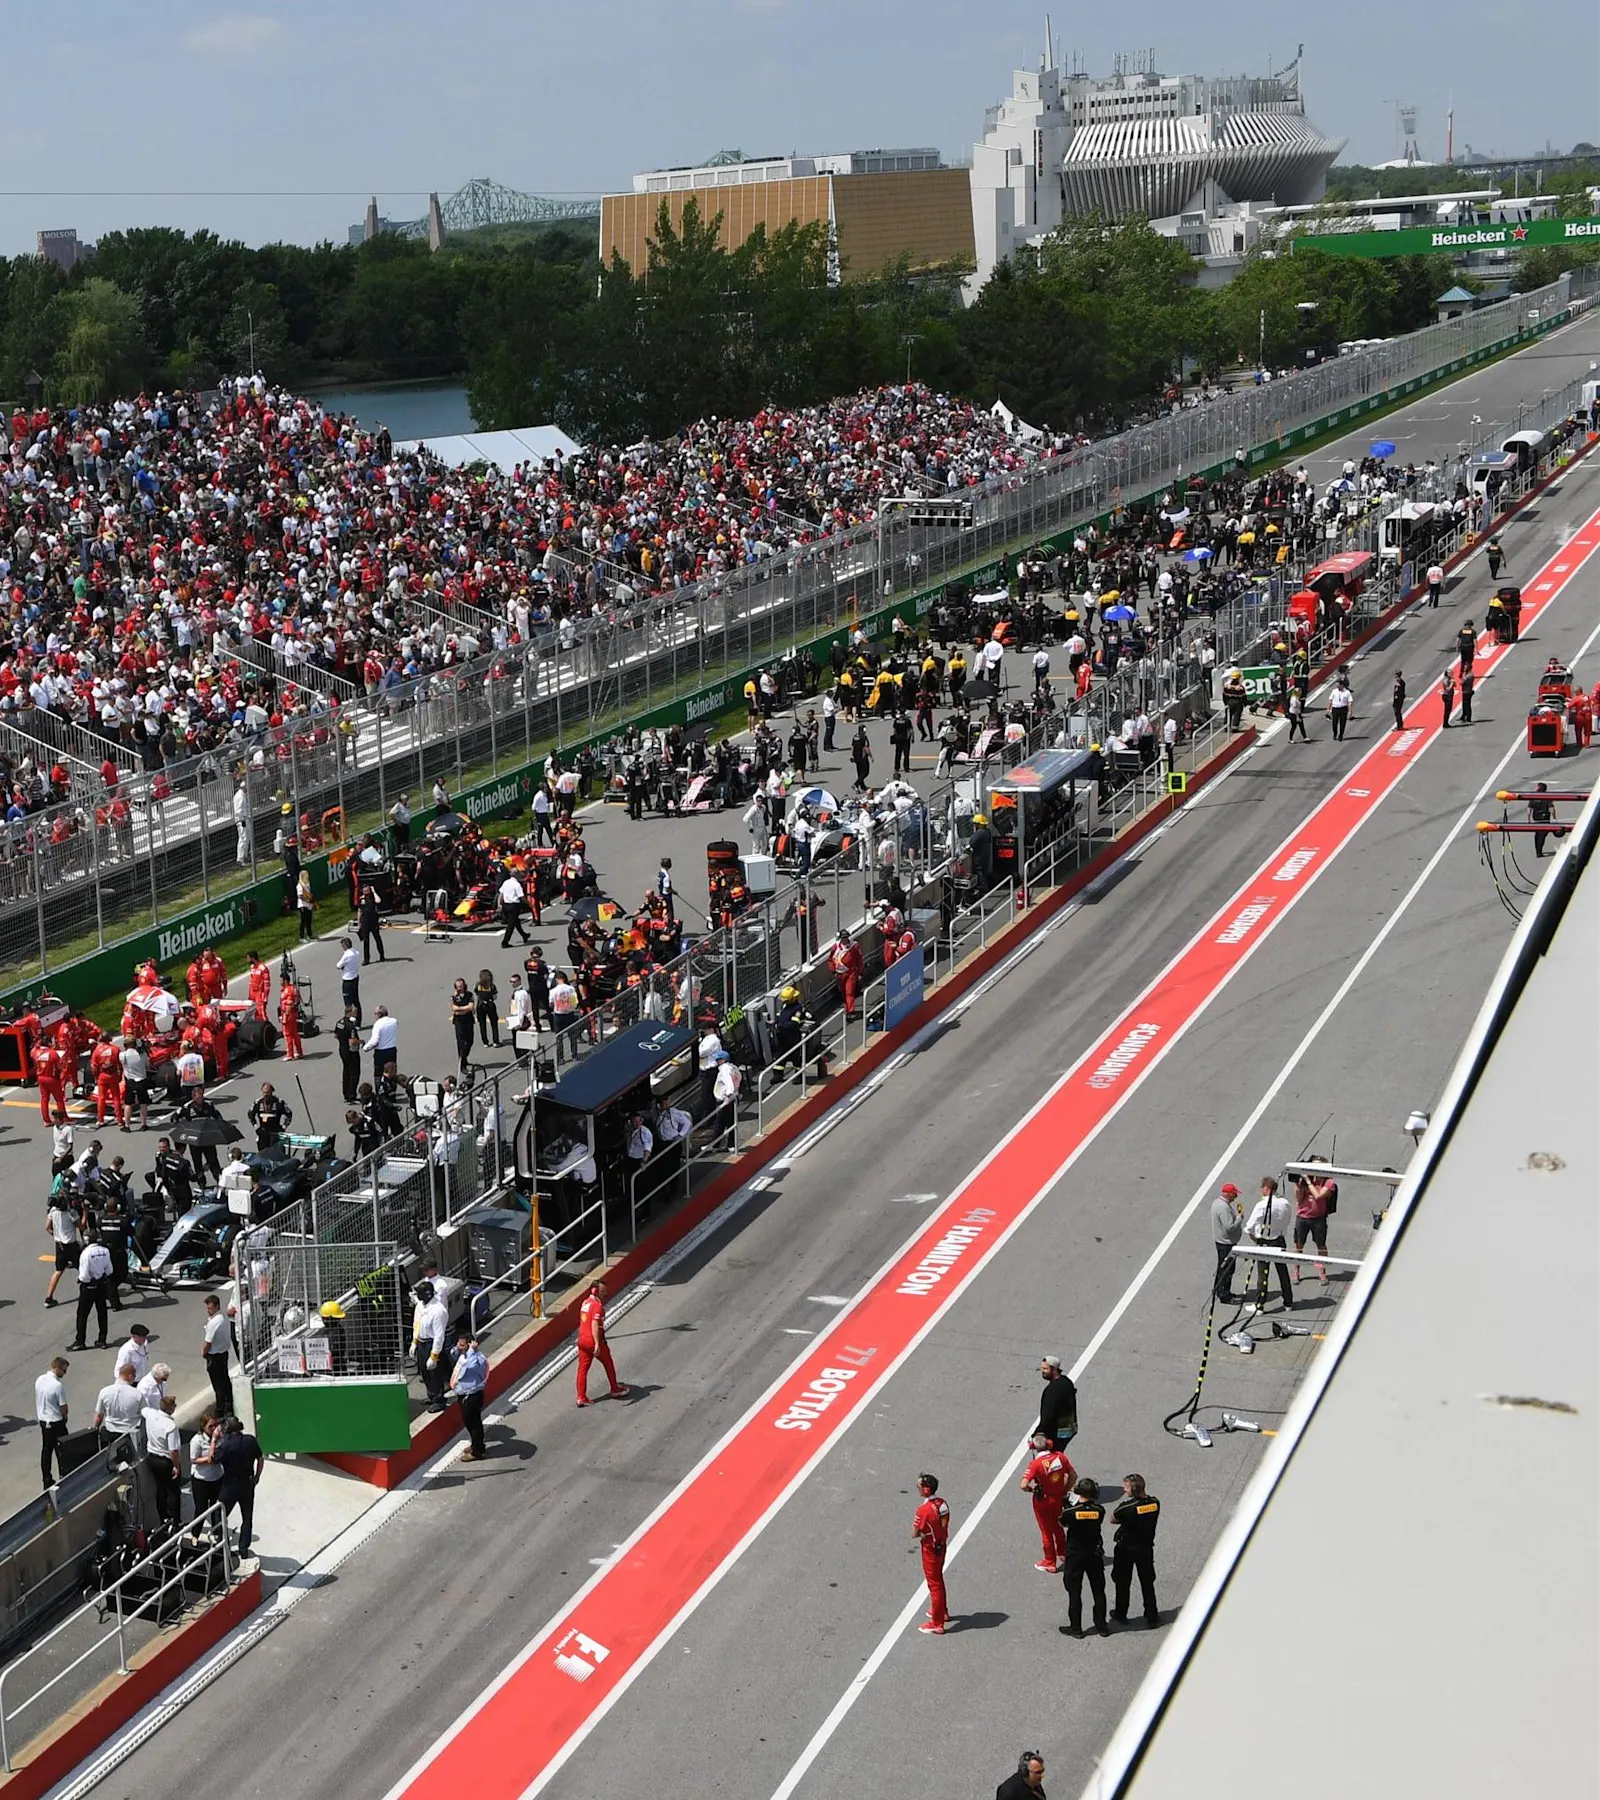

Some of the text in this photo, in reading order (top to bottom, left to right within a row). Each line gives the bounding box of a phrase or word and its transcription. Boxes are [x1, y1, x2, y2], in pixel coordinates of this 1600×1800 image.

[1432, 230, 1506, 246] Heineken
[686, 689, 725, 722] Heineken
[466, 781, 518, 818] Heineken
[158, 909, 235, 962] Heineken
[723, 1005, 744, 1029] LEWIS
[1084, 1023, 1161, 1089] #CANADIANGP
[895, 1225, 984, 1296] HAMILTON
[774, 1367, 858, 1431] BOTTAS
